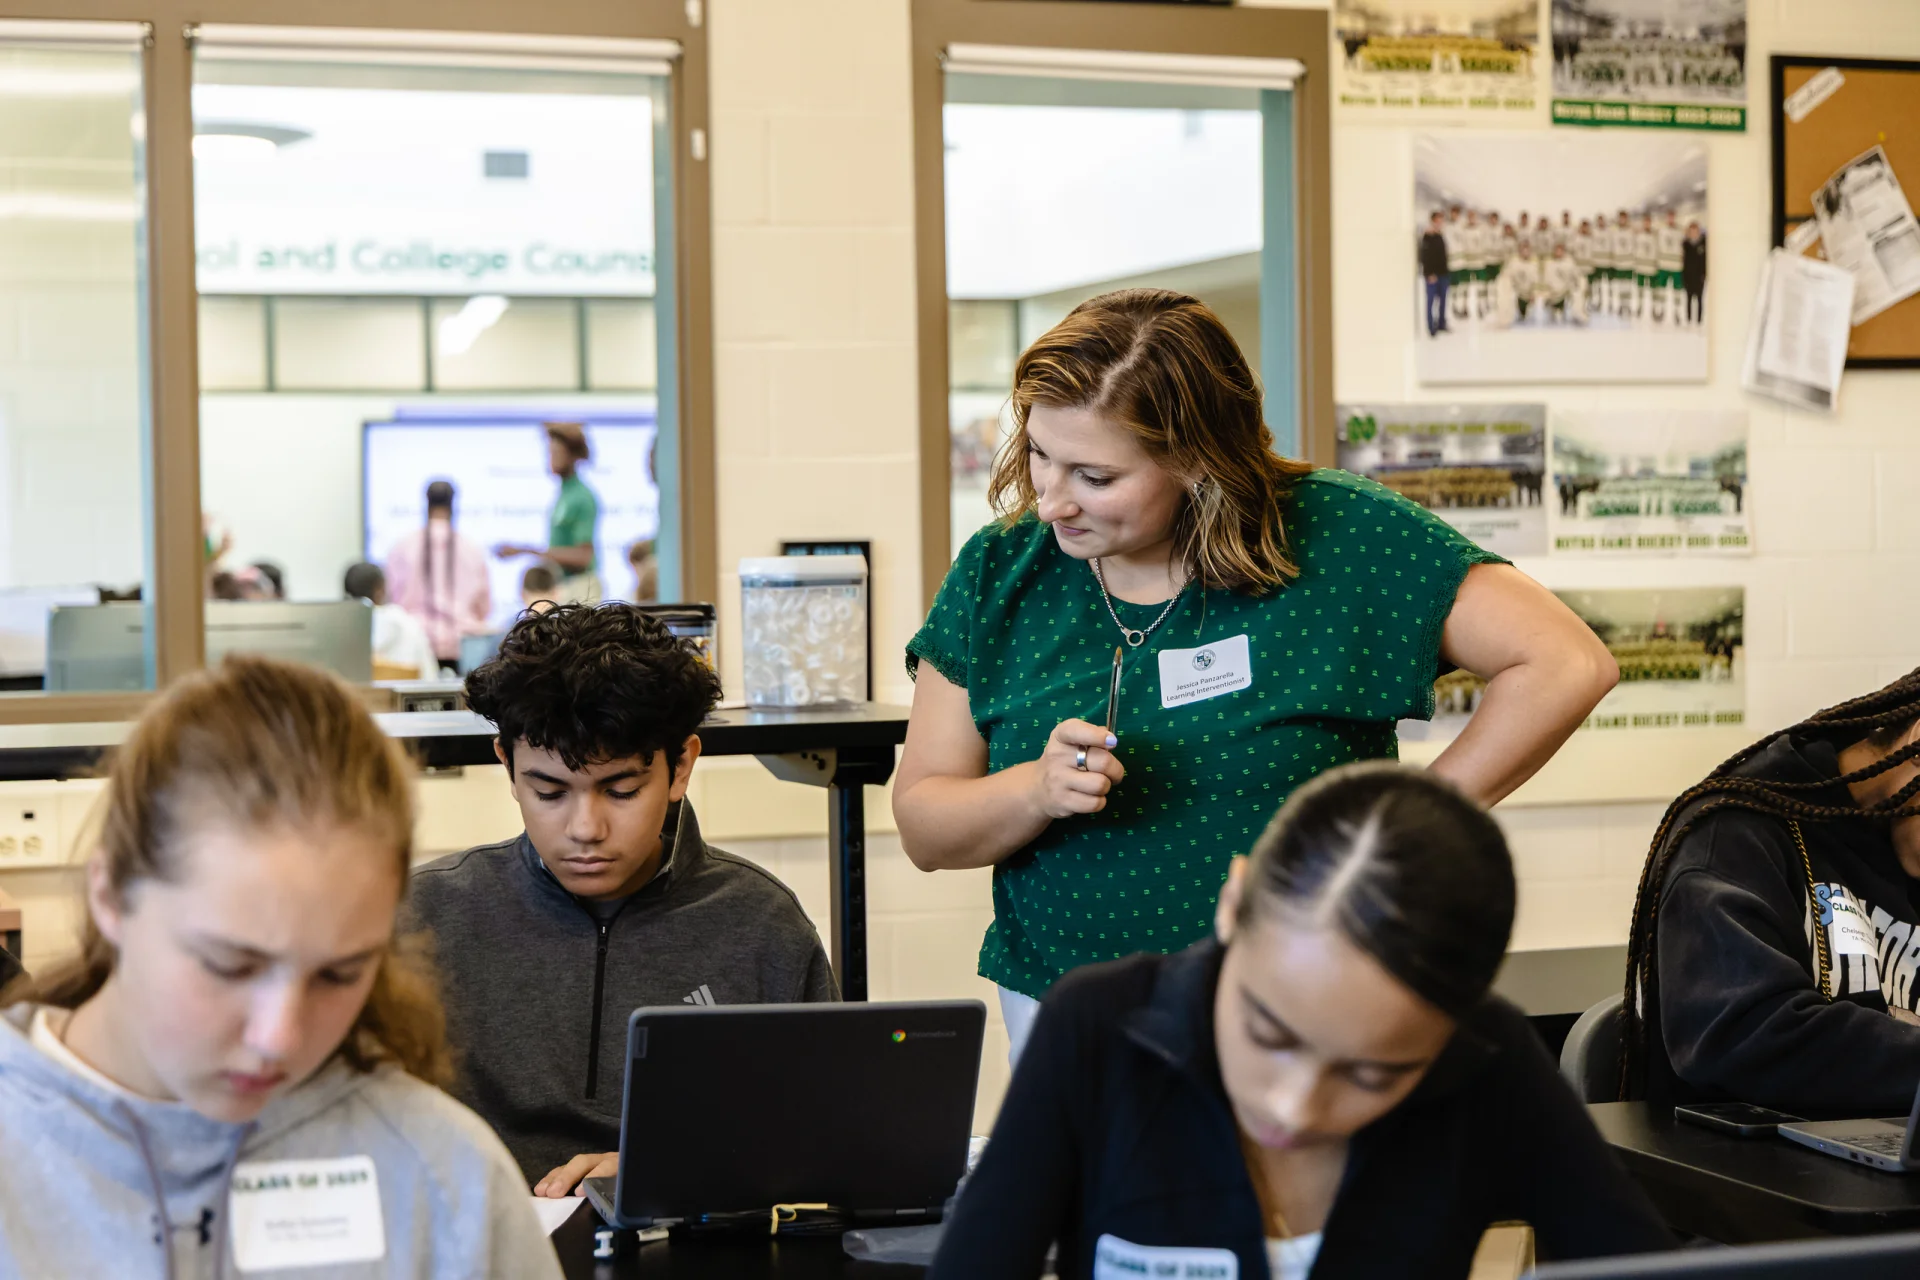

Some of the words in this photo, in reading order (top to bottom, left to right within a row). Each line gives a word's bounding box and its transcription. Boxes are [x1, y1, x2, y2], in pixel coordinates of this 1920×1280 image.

[256, 235, 337, 272] and
[350, 237, 509, 278] College
[1637, 534, 1682, 548] HOCKEY
[1166, 690, 1196, 701] Learning
[1196, 677, 1245, 695] Interventionist
[1176, 680, 1199, 691] Jessica
[1200, 671, 1234, 685] Panzarella
[1632, 713, 1678, 728] HOCKEY
[1832, 902, 1858, 916] CLASS
[232, 1175, 292, 1193] CLASS
